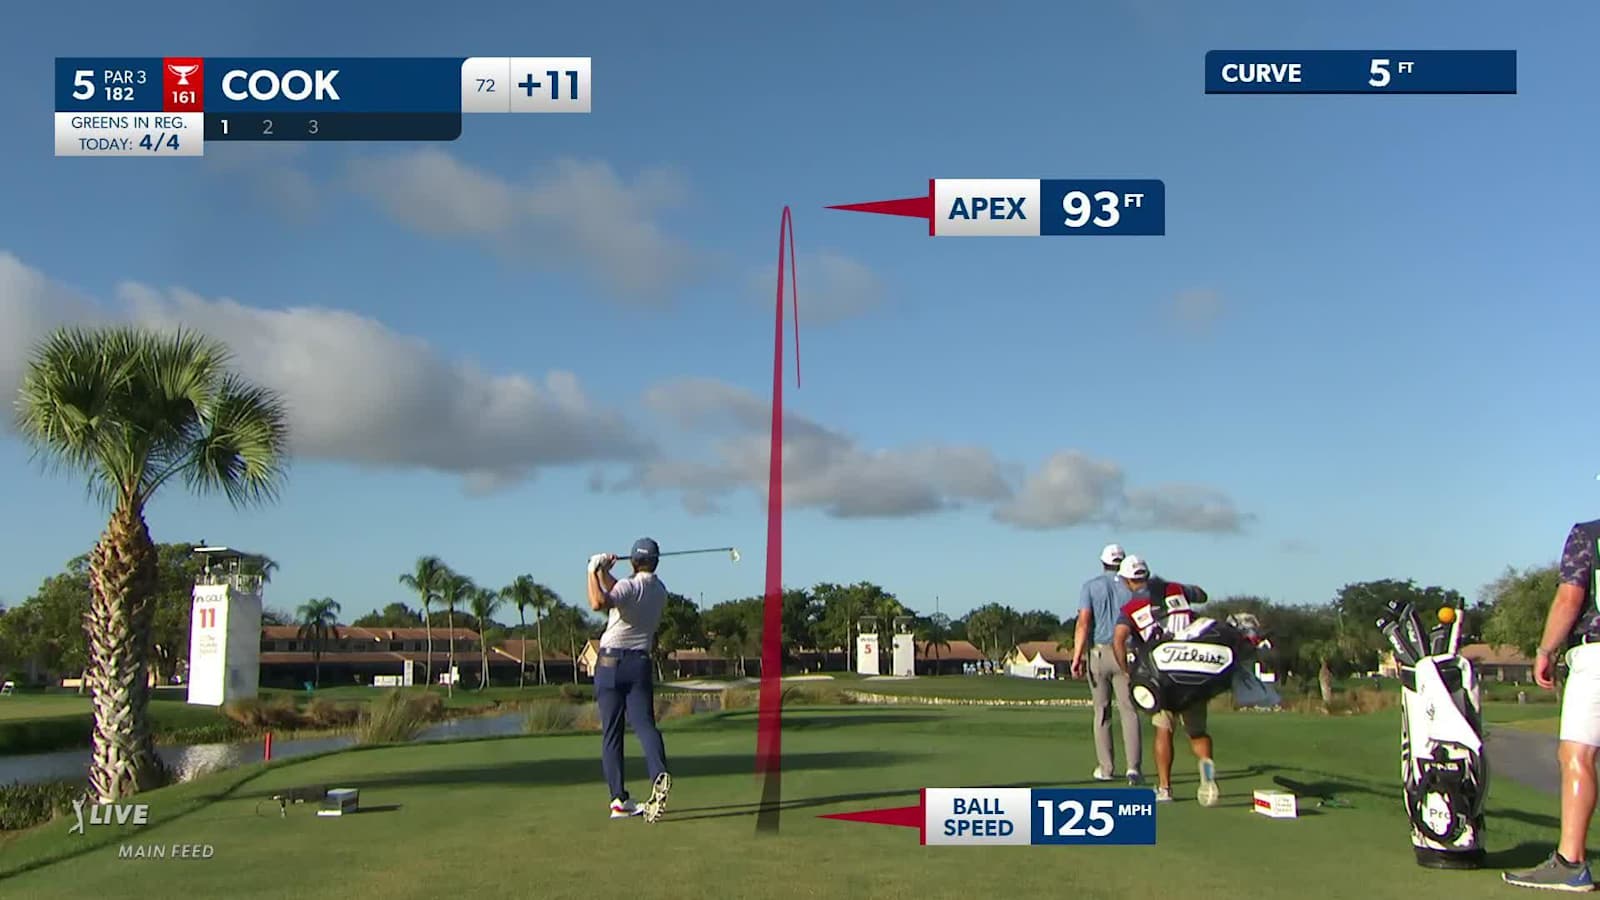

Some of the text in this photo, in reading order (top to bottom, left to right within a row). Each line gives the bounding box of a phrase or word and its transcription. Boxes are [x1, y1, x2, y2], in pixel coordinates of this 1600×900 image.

[199, 607, 216, 629] 11
[863, 643, 873, 655] 5
[1160, 645, 1226, 666] Titleist
